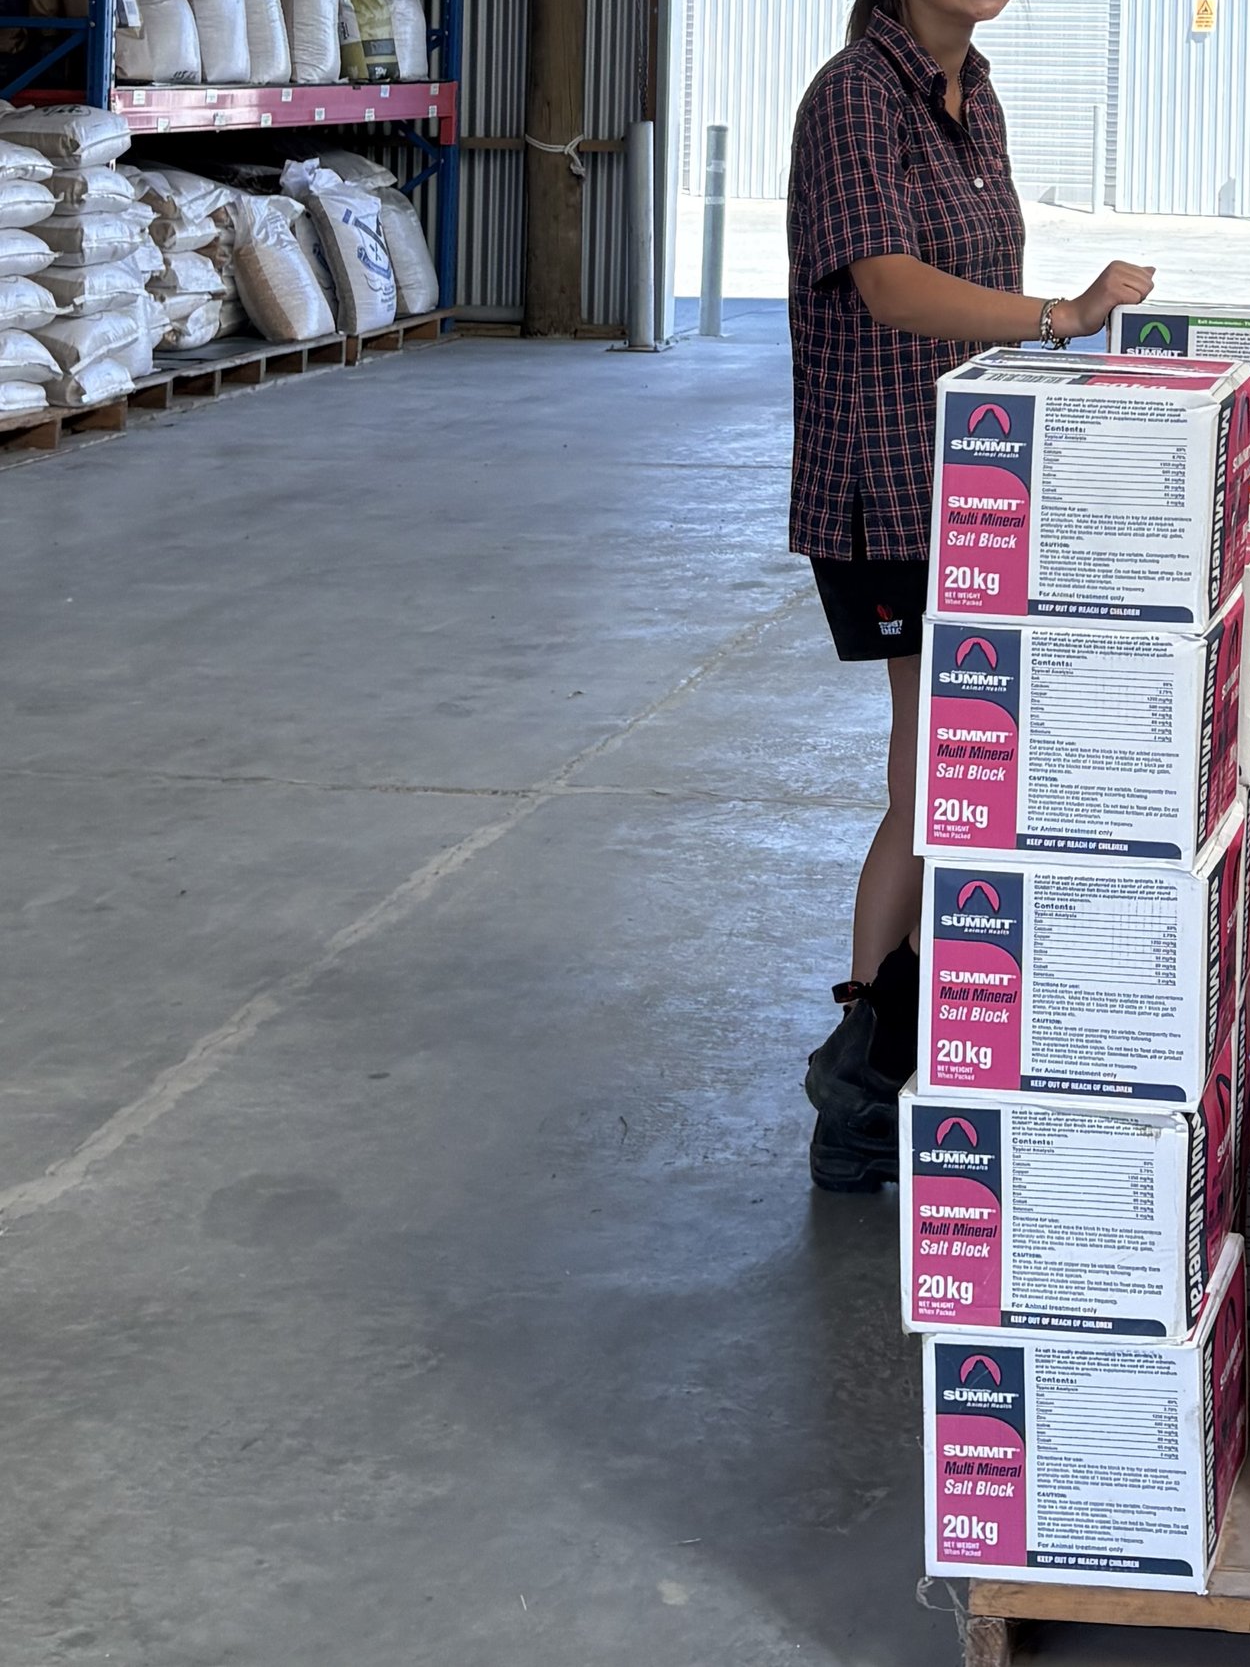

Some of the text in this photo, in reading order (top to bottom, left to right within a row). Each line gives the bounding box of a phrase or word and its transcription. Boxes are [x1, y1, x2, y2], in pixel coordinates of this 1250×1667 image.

[951, 440, 1023, 452] SUMMIT
[948, 496, 1020, 510] SUMMIT
[948, 511, 1025, 528] Multi Mineral
[947, 531, 1017, 548] Salt Block
[945, 566, 1000, 595] 20kg
[941, 915, 1012, 928] SUMMIT
[939, 971, 1012, 986] SUMMIT
[940, 986, 1018, 1003] Multi Mineral
[939, 1005, 1009, 1023] Salt Block
[937, 1039, 992, 1069] 20kg
[1093, 1083, 1101, 1091] OF
[1189, 1114, 1205, 1316] Multi Mineral
[918, 1275, 974, 1304] 20kg
[943, 1515, 998, 1544] 20kg
